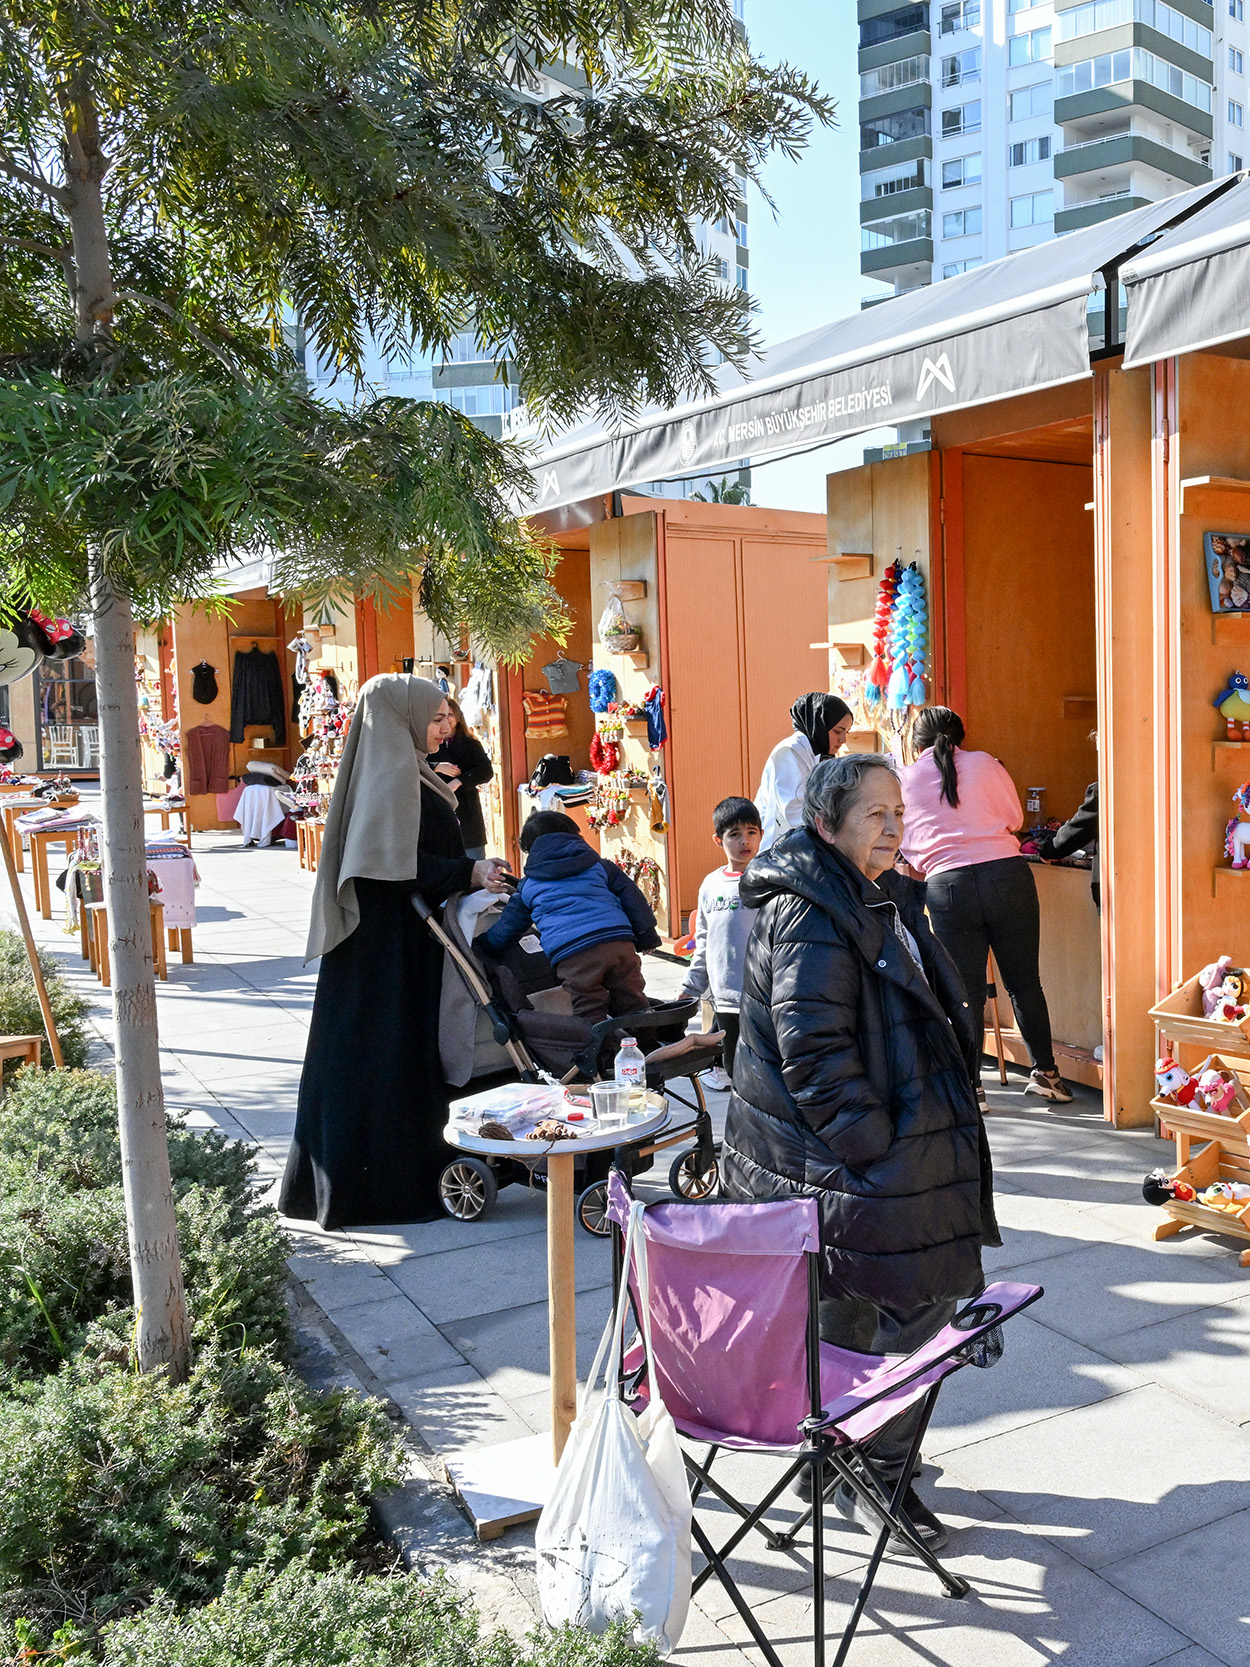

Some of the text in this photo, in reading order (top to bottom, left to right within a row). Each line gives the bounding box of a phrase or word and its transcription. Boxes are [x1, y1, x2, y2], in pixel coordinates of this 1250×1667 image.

[728, 416, 764, 444] MERSİN
[765, 400, 827, 432] BÜYÜKŞEHİR
[828, 380, 893, 419] BELEDİYESİ
